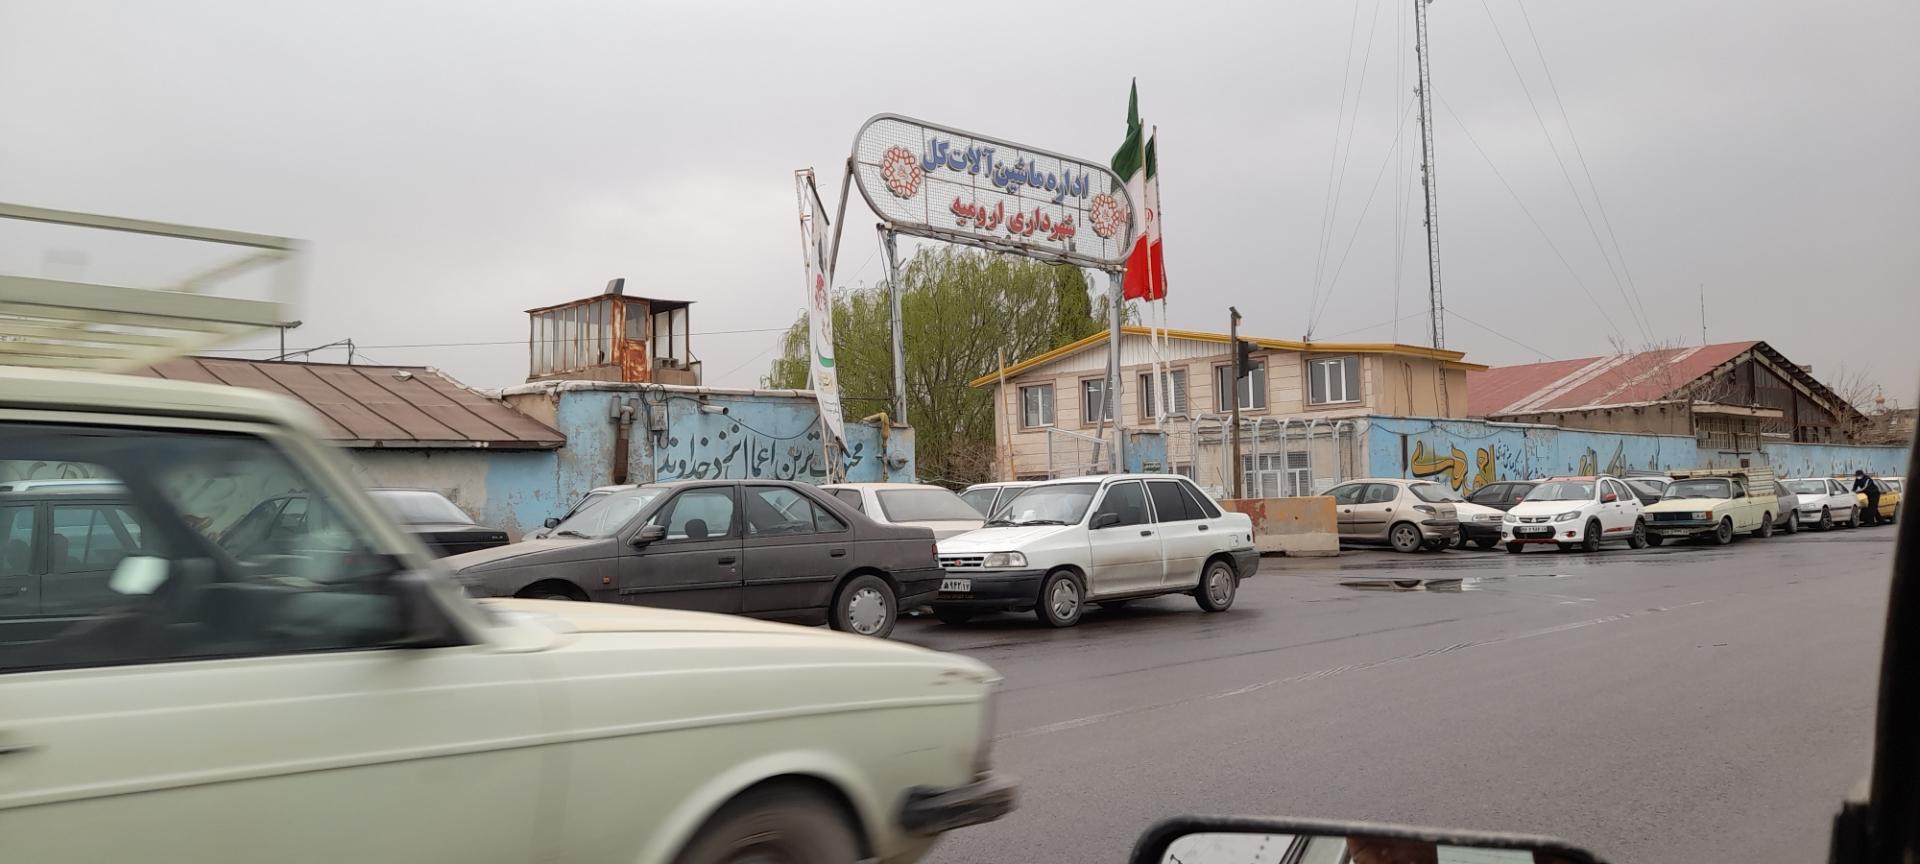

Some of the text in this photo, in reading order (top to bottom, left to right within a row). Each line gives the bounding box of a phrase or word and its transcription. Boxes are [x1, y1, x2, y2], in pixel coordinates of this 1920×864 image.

[922, 138, 1088, 204] اداره ماشین آلات کل
[950, 196, 1076, 241] شهرداری ارومیه
[657, 433, 711, 480] خداوند
